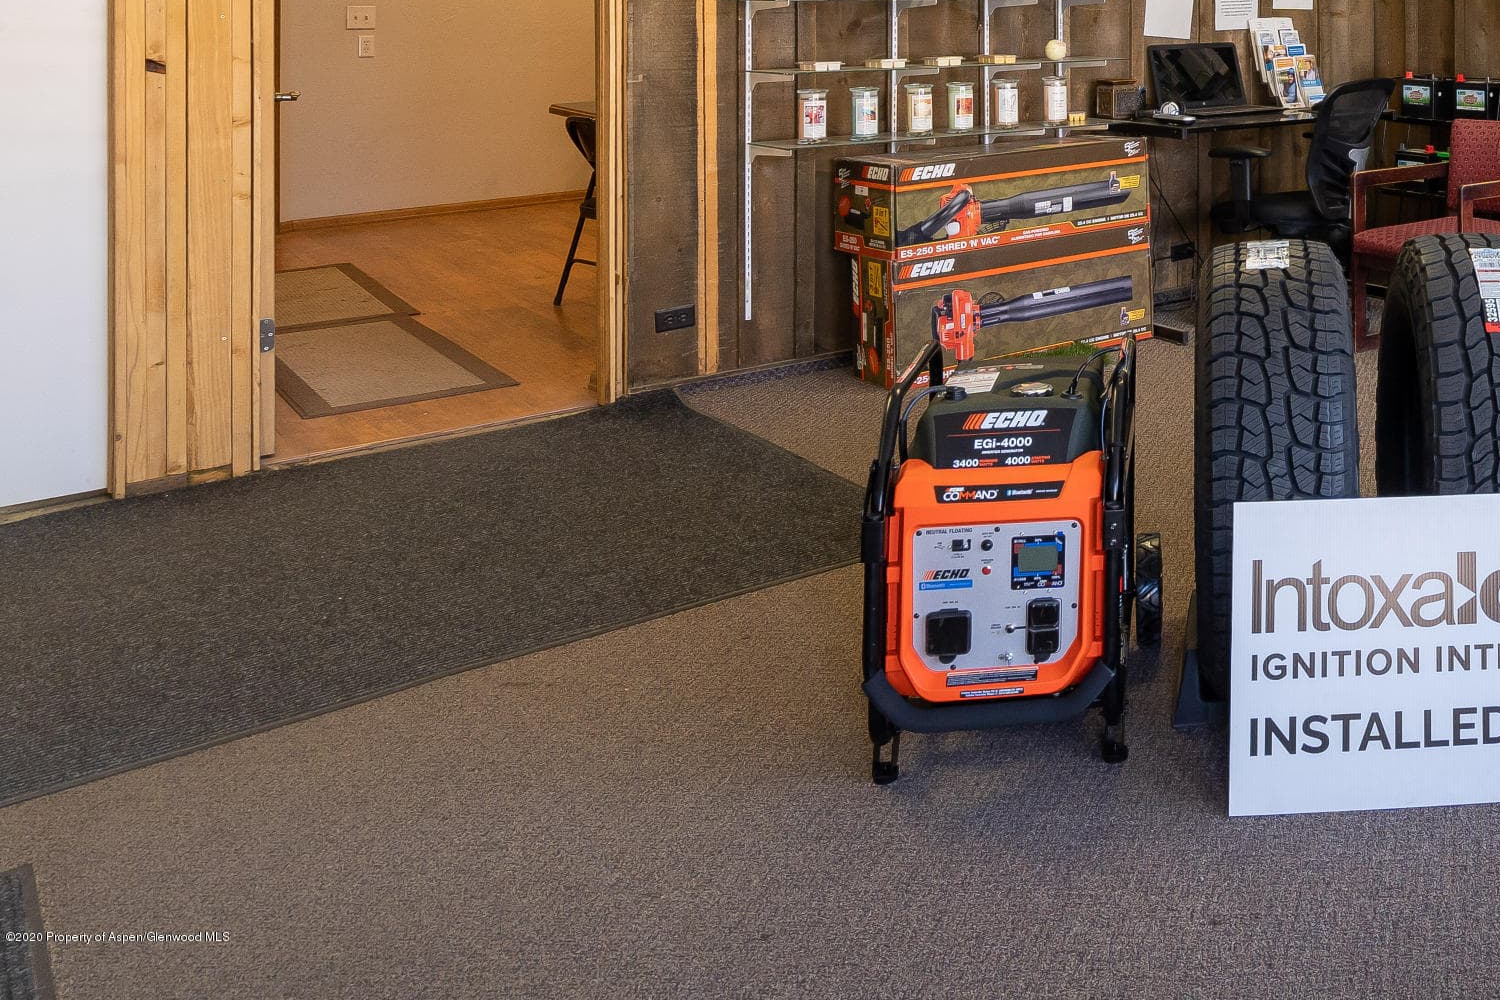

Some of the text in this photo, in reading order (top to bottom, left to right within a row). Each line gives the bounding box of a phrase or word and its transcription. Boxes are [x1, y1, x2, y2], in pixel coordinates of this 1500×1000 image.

[867, 165, 889, 181] ECHO
[911, 163, 956, 181] ECHO
[900, 247, 934, 259] ES-250
[935, 242, 968, 253] SHRED
[981, 235, 1000, 246] VAC
[910, 258, 956, 278] ECHO
[1484, 298, 1499, 323] 32595
[981, 410, 1048, 429] ECHO
[974, 437, 1033, 449] EGi-4000
[952, 456, 1031, 468] 3400 4000
[943, 489, 999, 501] COMMAND
[933, 568, 970, 580] ECHO
[1251, 647, 1420, 681] IGNITION
